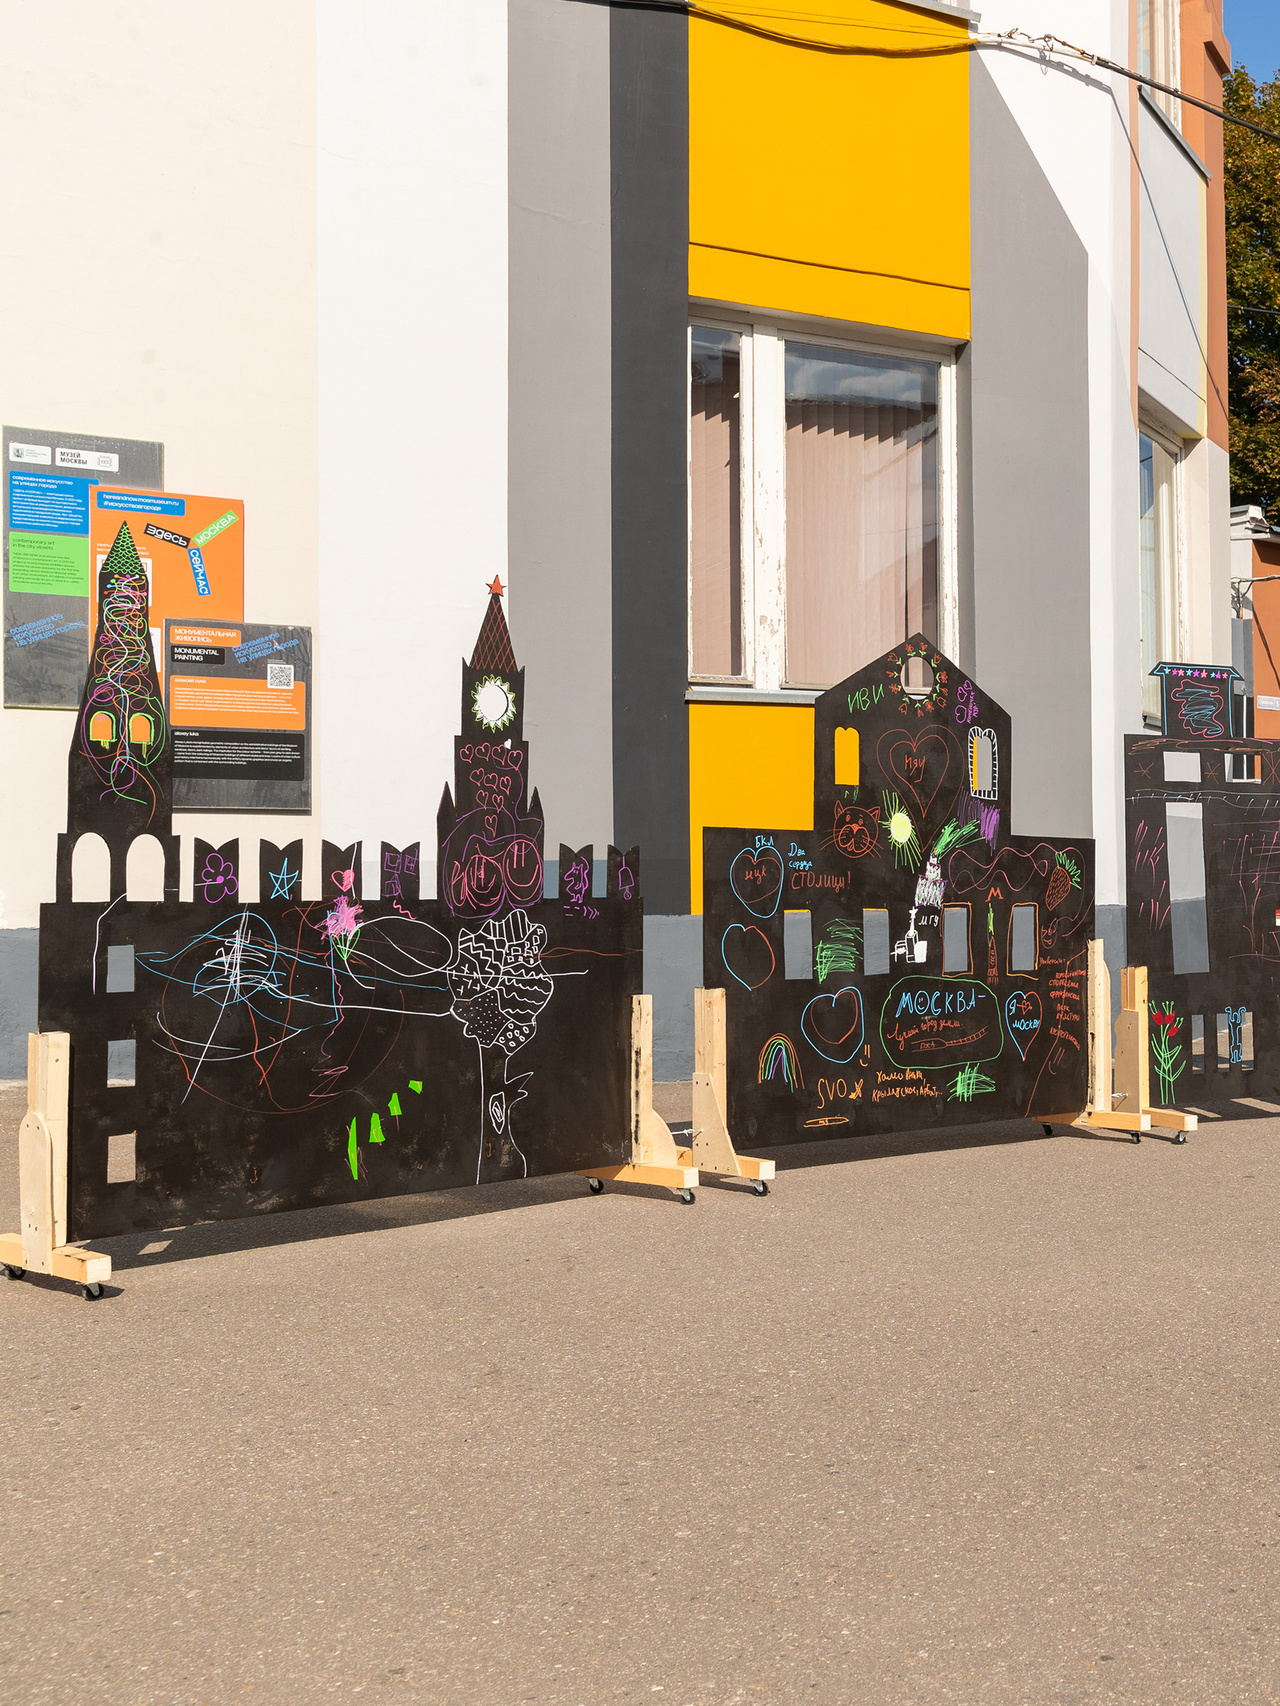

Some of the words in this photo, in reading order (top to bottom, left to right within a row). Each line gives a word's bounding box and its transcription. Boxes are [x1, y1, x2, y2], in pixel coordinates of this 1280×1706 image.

[60, 451, 82, 459] МУЗЕЙ
[60, 457, 88, 466] МОСКВЫ
[194, 513, 236, 546] МОСКВА
[146, 524, 188, 548] здесь
[174, 628, 237, 639] МОНУМЕНТАЛЬНАЯ
[174, 635, 213, 644] ЖИВОПИСЬ
[174, 647, 220, 656] MONUMENTAL
[174, 654, 204, 662] PAINTING
